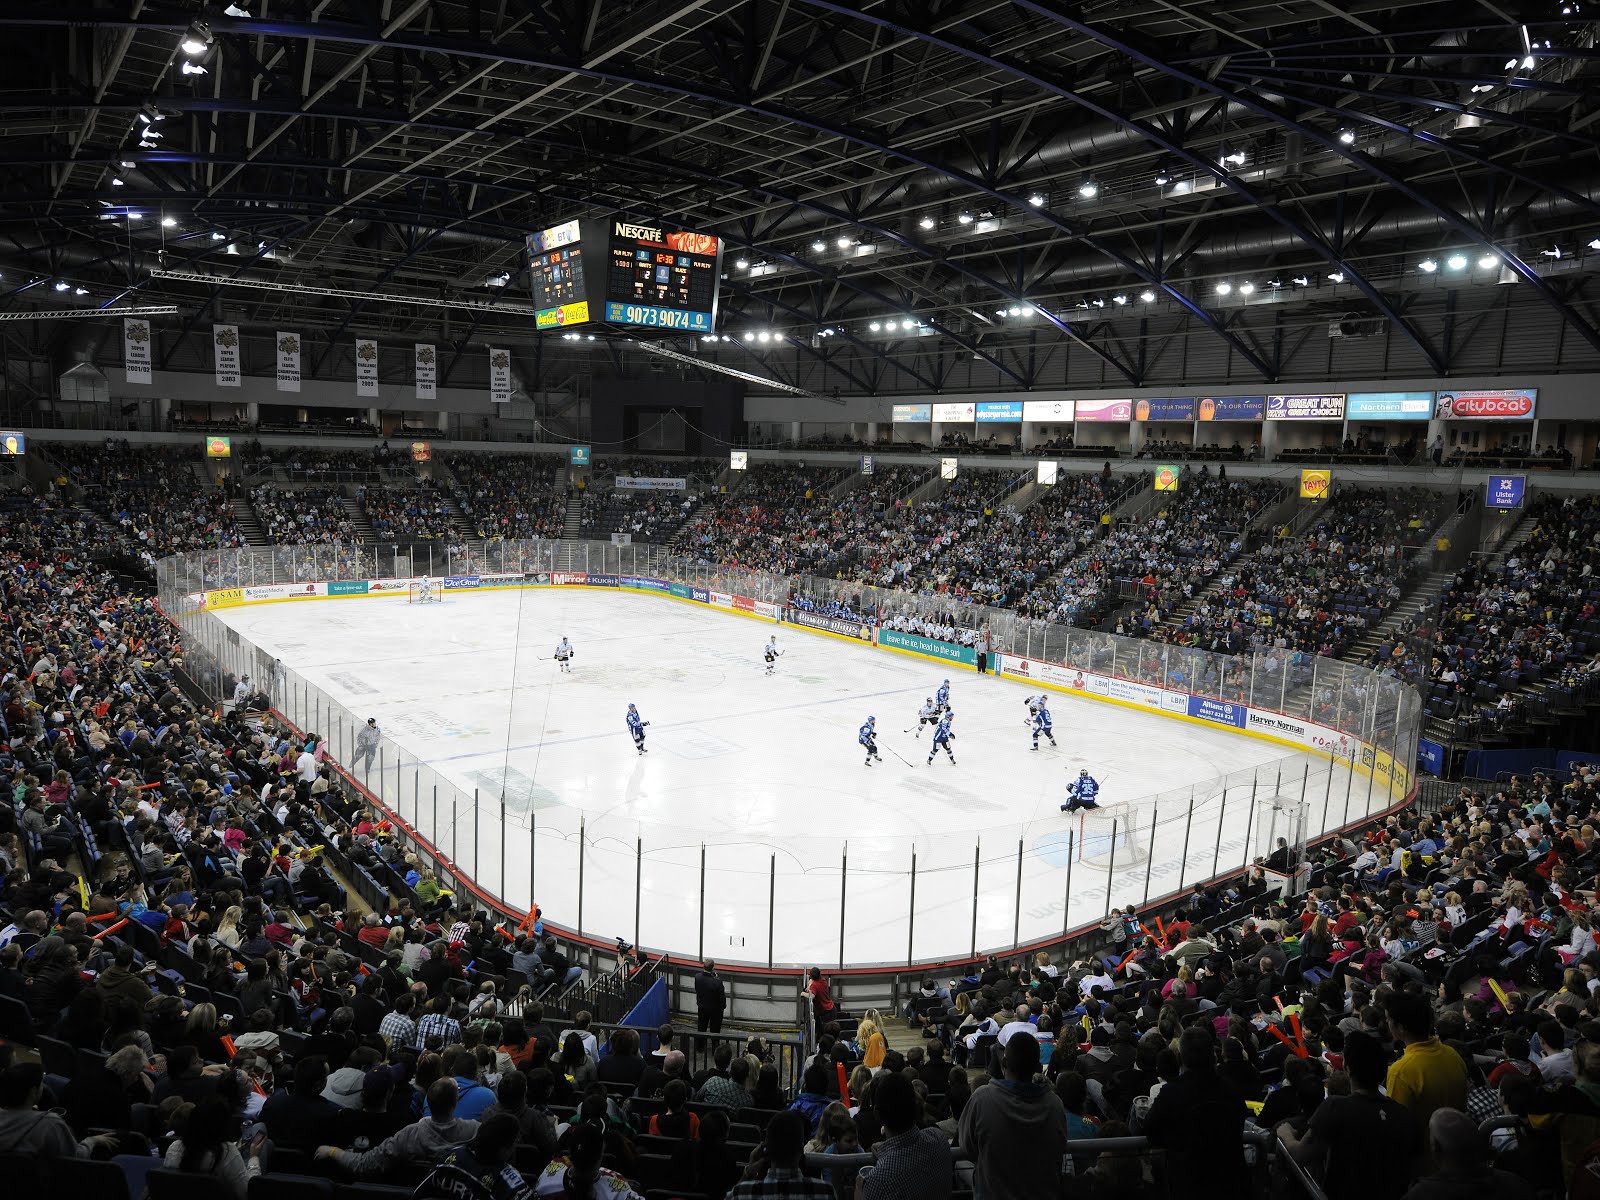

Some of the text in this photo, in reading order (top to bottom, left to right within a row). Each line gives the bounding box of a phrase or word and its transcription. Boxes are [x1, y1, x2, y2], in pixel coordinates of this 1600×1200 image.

[615, 222, 662, 243] NESCAFÉ
[626, 306, 689, 328] 9073 9074
[1286, 398, 1342, 408] GREAT FUN
[1456, 398, 1527, 414] citybeat
[1303, 479, 1327, 490] TAYTO
[554, 574, 585, 584] Mirror
[886, 634, 900, 644] Leave
[901, 637, 909, 645] the
[910, 639, 918, 649] ice,
[920, 641, 932, 652] head
[940, 646, 949, 655] the
[950, 649, 960, 658] sun
[1170, 696, 1185, 705] LBM
[1202, 701, 1223, 710] Allianz
[1250, 714, 1305, 734] Harvey Norman
[1082, 784, 1094, 794] 35
